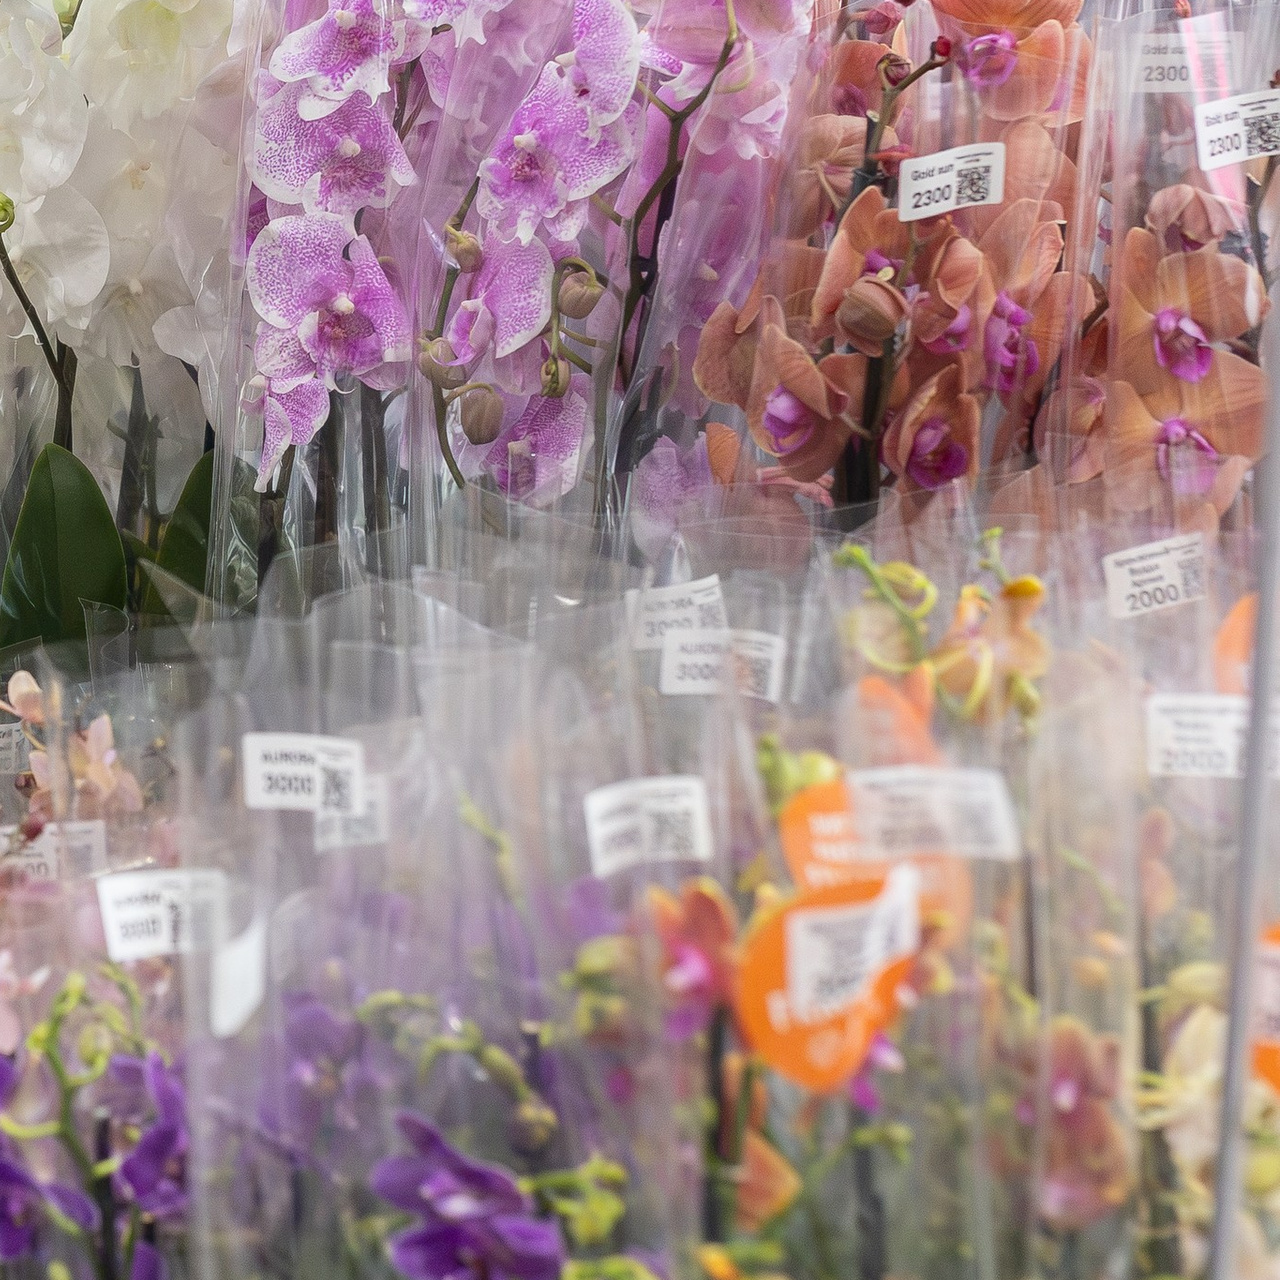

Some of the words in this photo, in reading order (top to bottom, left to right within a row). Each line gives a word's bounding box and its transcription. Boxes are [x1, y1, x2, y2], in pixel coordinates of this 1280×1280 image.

[1144, 65, 1190, 82] 2300
[911, 183, 952, 209] 2300
[1126, 583, 1180, 611] 2000
